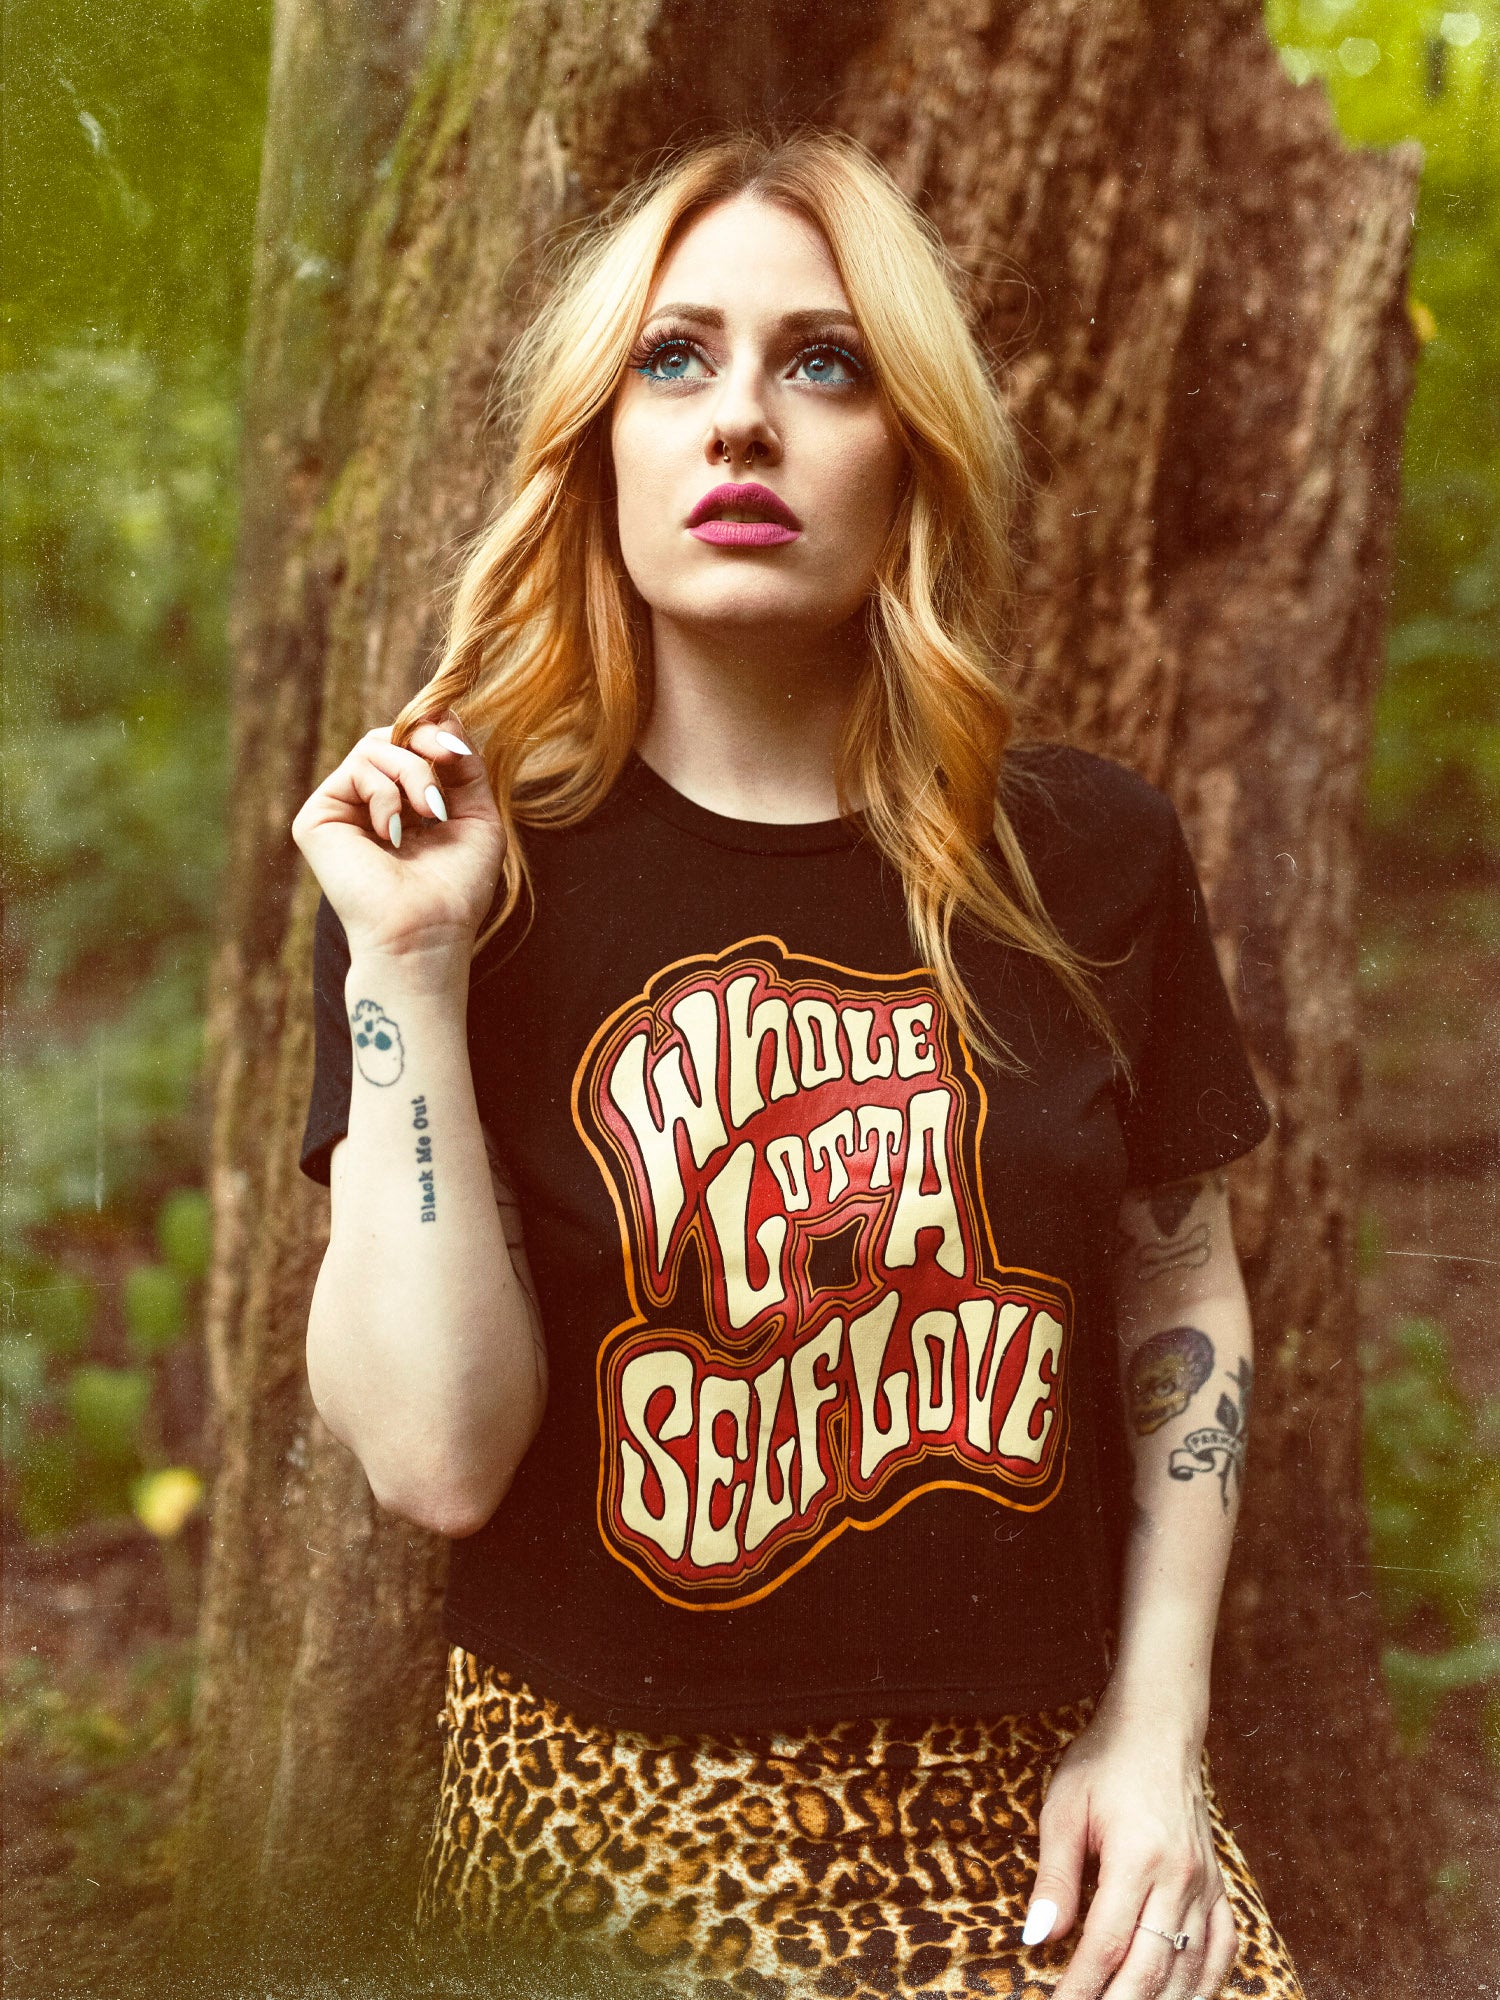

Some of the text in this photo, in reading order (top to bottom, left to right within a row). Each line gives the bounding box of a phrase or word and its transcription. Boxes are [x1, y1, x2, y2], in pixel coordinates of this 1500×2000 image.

[411, 1094, 436, 1223] Black Me Out
[706, 1090, 966, 1330] LOTTA
[620, 1292, 1064, 1567] SELF LOVE
